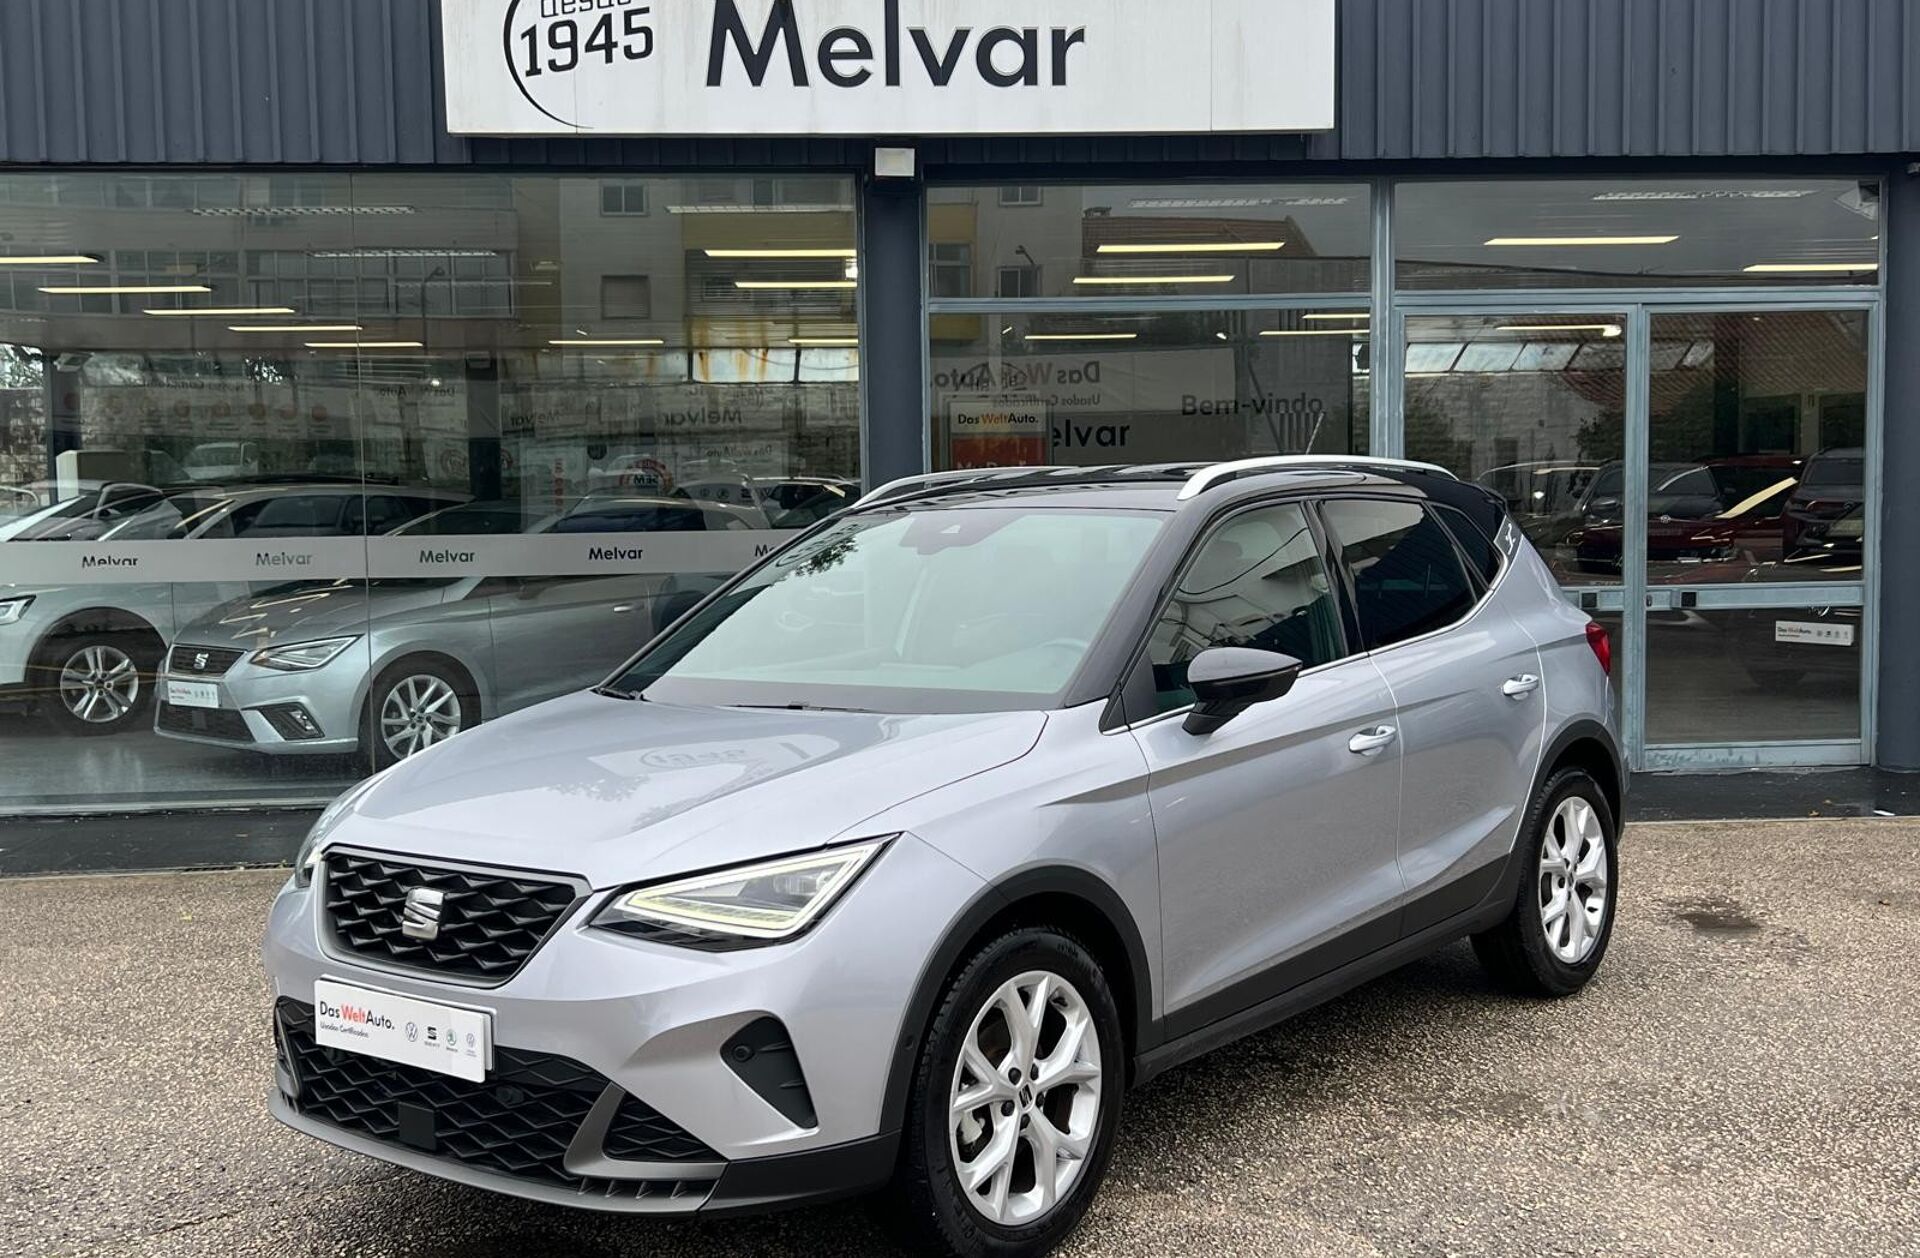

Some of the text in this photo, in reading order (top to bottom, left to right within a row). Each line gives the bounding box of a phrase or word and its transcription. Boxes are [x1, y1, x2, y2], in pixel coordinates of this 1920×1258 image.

[520, 6, 654, 78] 1945
[706, 0, 1087, 88] Melvar
[1181, 392, 1323, 416] Bem-vindo
[82, 555, 139, 568] Melvar
[255, 552, 313, 566] Melvar
[419, 549, 476, 564] Melvar
[588, 547, 643, 561] Melvar
[319, 1001, 340, 1019] Das
